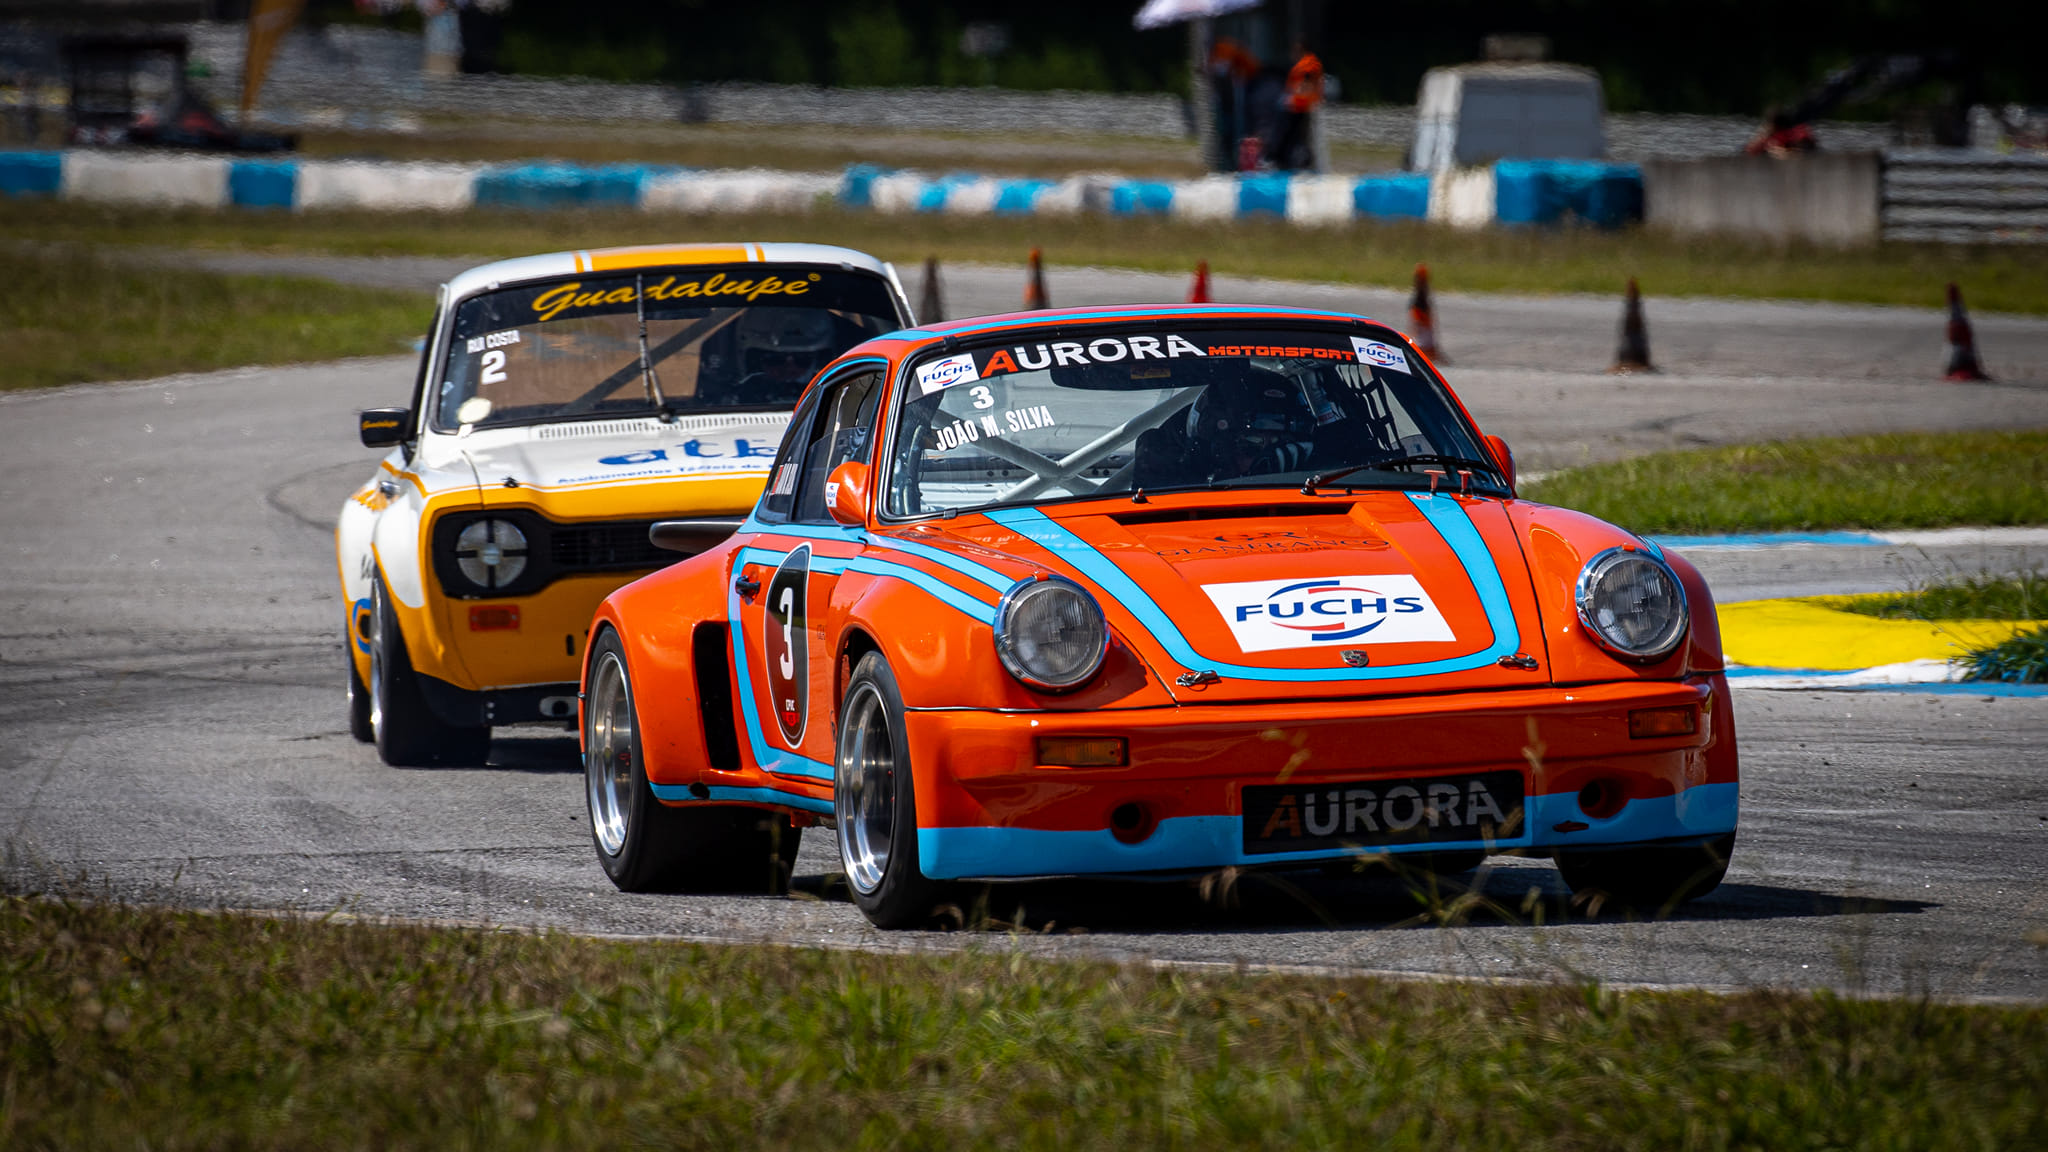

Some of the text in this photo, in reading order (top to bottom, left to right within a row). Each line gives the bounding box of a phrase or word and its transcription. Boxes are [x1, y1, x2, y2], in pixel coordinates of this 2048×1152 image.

[486, 329, 521, 349] COSTA
[480, 350, 508, 385] 2
[980, 334, 1208, 379] AURORA
[1208, 346, 1356, 361] MOTORSPORT
[1358, 346, 1405, 364] FUCHS
[922, 364, 973, 384] FUCHS
[969, 385, 995, 410] 3
[936, 405, 1056, 452] JOÃO M. SILVA
[1236, 597, 1425, 622] FUCHS
[779, 587, 794, 681] 3
[1260, 780, 1505, 839] AURORA
